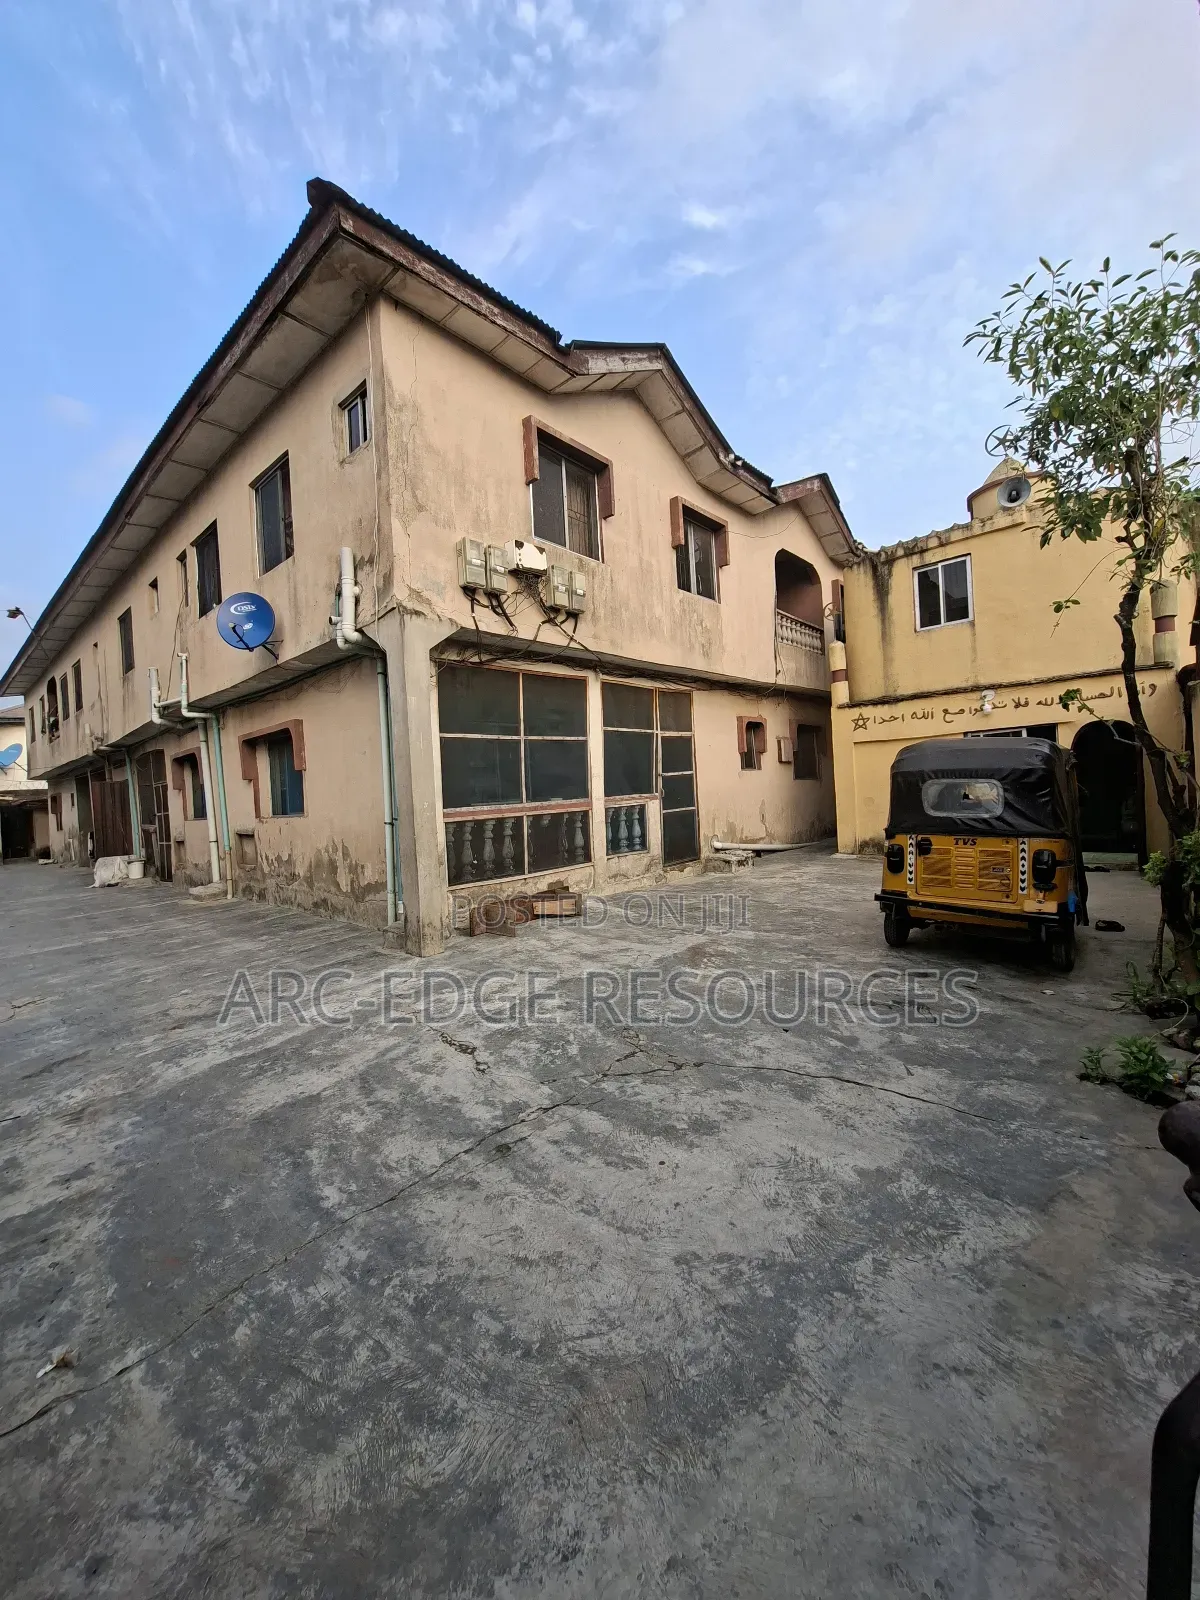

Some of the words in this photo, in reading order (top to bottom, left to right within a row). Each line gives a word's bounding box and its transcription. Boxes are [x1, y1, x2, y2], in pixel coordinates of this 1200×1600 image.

[1035, 696, 1054, 706] لله
[1056, 685, 1122, 706] المسا
[1011, 696, 1029, 709] فلا
[953, 838, 977, 846] TVS
